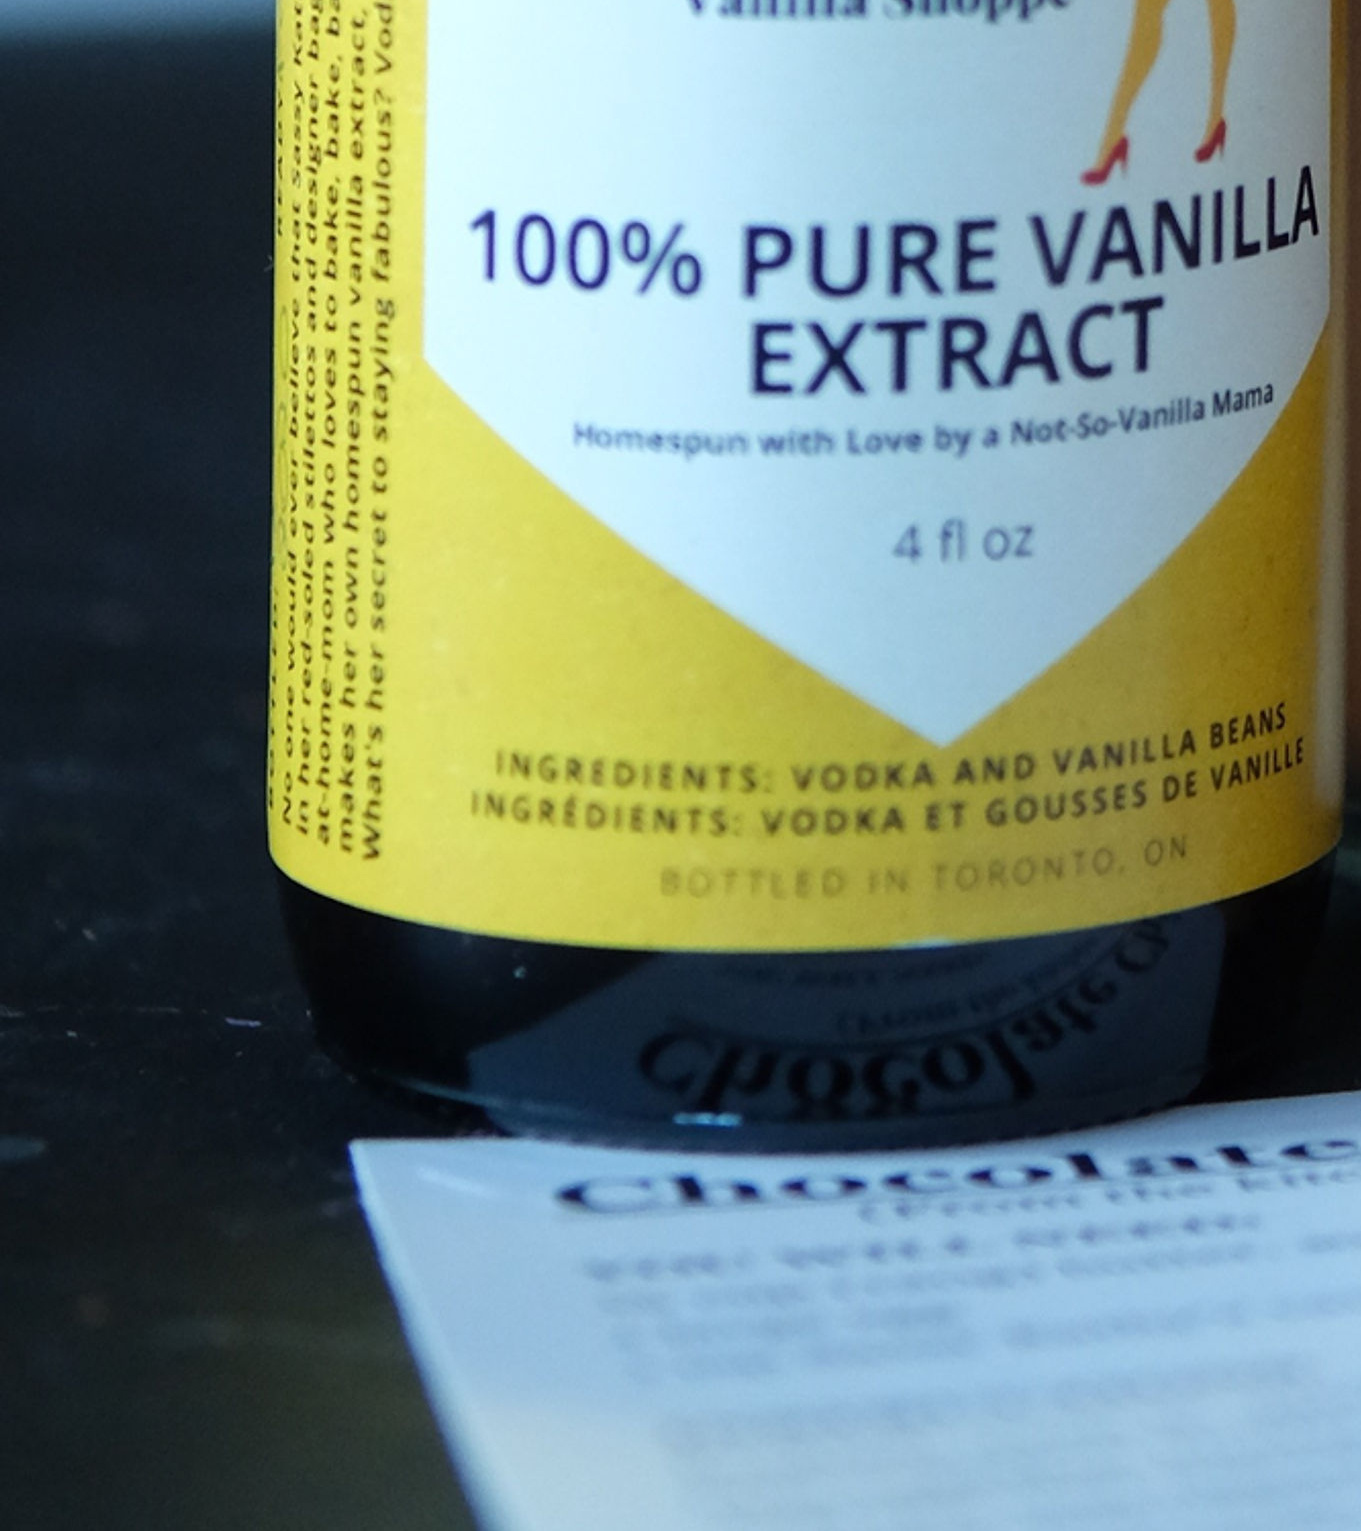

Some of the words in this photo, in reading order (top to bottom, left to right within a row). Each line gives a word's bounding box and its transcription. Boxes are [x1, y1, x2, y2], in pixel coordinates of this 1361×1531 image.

[325, 55, 342, 158] bake,
[347, 8, 368, 159] extract,
[291, 82, 304, 189] Sassy
[305, 74, 322, 245] designer
[370, 89, 392, 282] fabulous?
[290, 202, 302, 282] that
[323, 176, 341, 280] bake,
[346, 176, 363, 306] vanilla
[470, 207, 703, 297] 100%
[742, 218, 998, 298] PURE
[1028, 164, 1321, 287] VANILLA
[304, 259, 317, 332] and
[324, 294, 337, 332] to
[750, 295, 1164, 397] EXTRACT
[289, 299, 300, 439] believe
[322, 348, 337, 448] loves
[371, 298, 394, 442] staying
[301, 346, 317, 509] stilettos
[342, 322, 364, 533] homespun
[573, 421, 750, 463] Homespun
[760, 420, 835, 457] with
[846, 417, 922, 455] Love
[934, 420, 972, 458] by
[980, 429, 1000, 450] a
[1010, 395, 1206, 447] Not-So-Vanilla
[1212, 381, 1274, 419] Mama
[289, 454, 299, 538] ever
[320, 463, 335, 544] who
[370, 456, 388, 493] to
[343, 546, 359, 629] own
[368, 510, 388, 631] secret
[892, 521, 924, 563] 4
[938, 517, 968, 563] fl
[982, 523, 1036, 562] oz
[286, 549, 297, 670] would
[298, 521, 315, 705] red-soled
[284, 686, 295, 757] one
[315, 560, 334, 846] at-home-mom
[339, 640, 357, 708] her
[364, 642, 384, 710] her
[282, 772, 293, 826] No
[296, 720, 311, 785] her
[337, 723, 356, 853] makes
[361, 725, 383, 861] What's
[472, 787, 742, 838] INGRÉDIENTS:
[762, 805, 904, 838] VODKA
[924, 802, 968, 832] ET
[984, 778, 1149, 828] GOUSSES
[1162, 768, 1199, 807] DE
[1210, 735, 1306, 794] VANILLE
[494, 747, 774, 796] INGREDIENTS:
[792, 761, 936, 795] VODKA
[953, 751, 1036, 789] AND
[1056, 727, 1197, 777] VANILLA
[1209, 701, 1288, 752] BEANS
[296, 799, 310, 835] in
[660, 865, 846, 901] BOTTLED
[866, 863, 912, 897] IN
[930, 844, 1128, 895] TORONTO,
[1143, 833, 1190, 869] ON
[555, 1139, 1361, 1212] Chocolate
